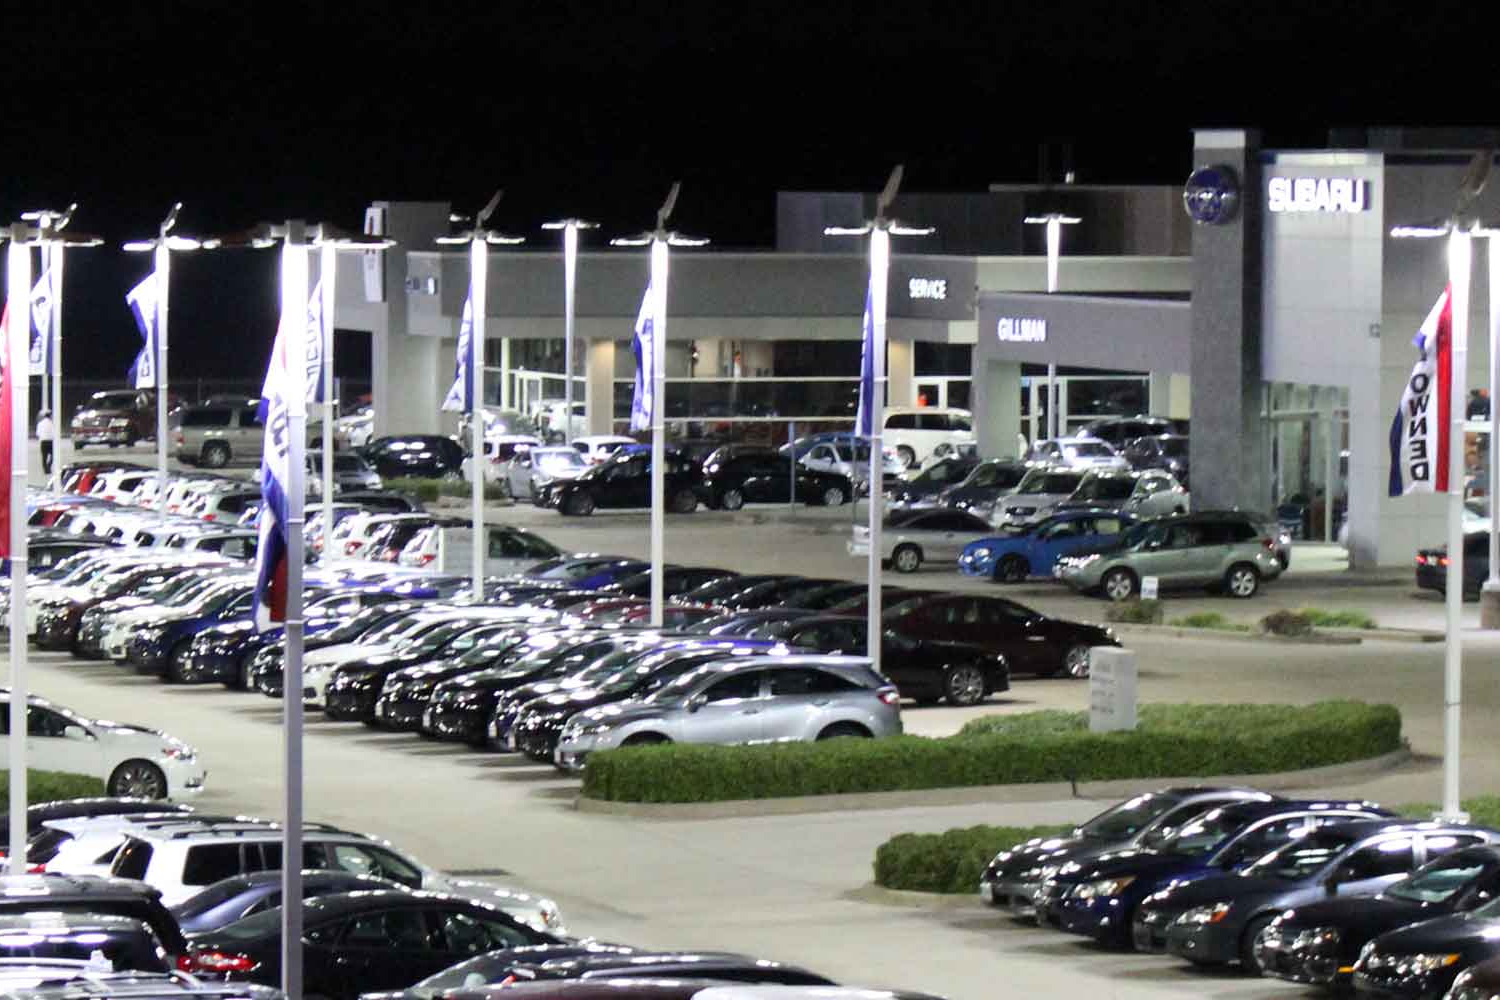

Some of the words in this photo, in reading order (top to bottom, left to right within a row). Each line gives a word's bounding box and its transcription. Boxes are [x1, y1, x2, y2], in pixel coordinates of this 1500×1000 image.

[1268, 177, 1365, 213] SUBARU
[909, 277, 947, 300] SERVICE
[998, 317, 1046, 342] GILLMAN
